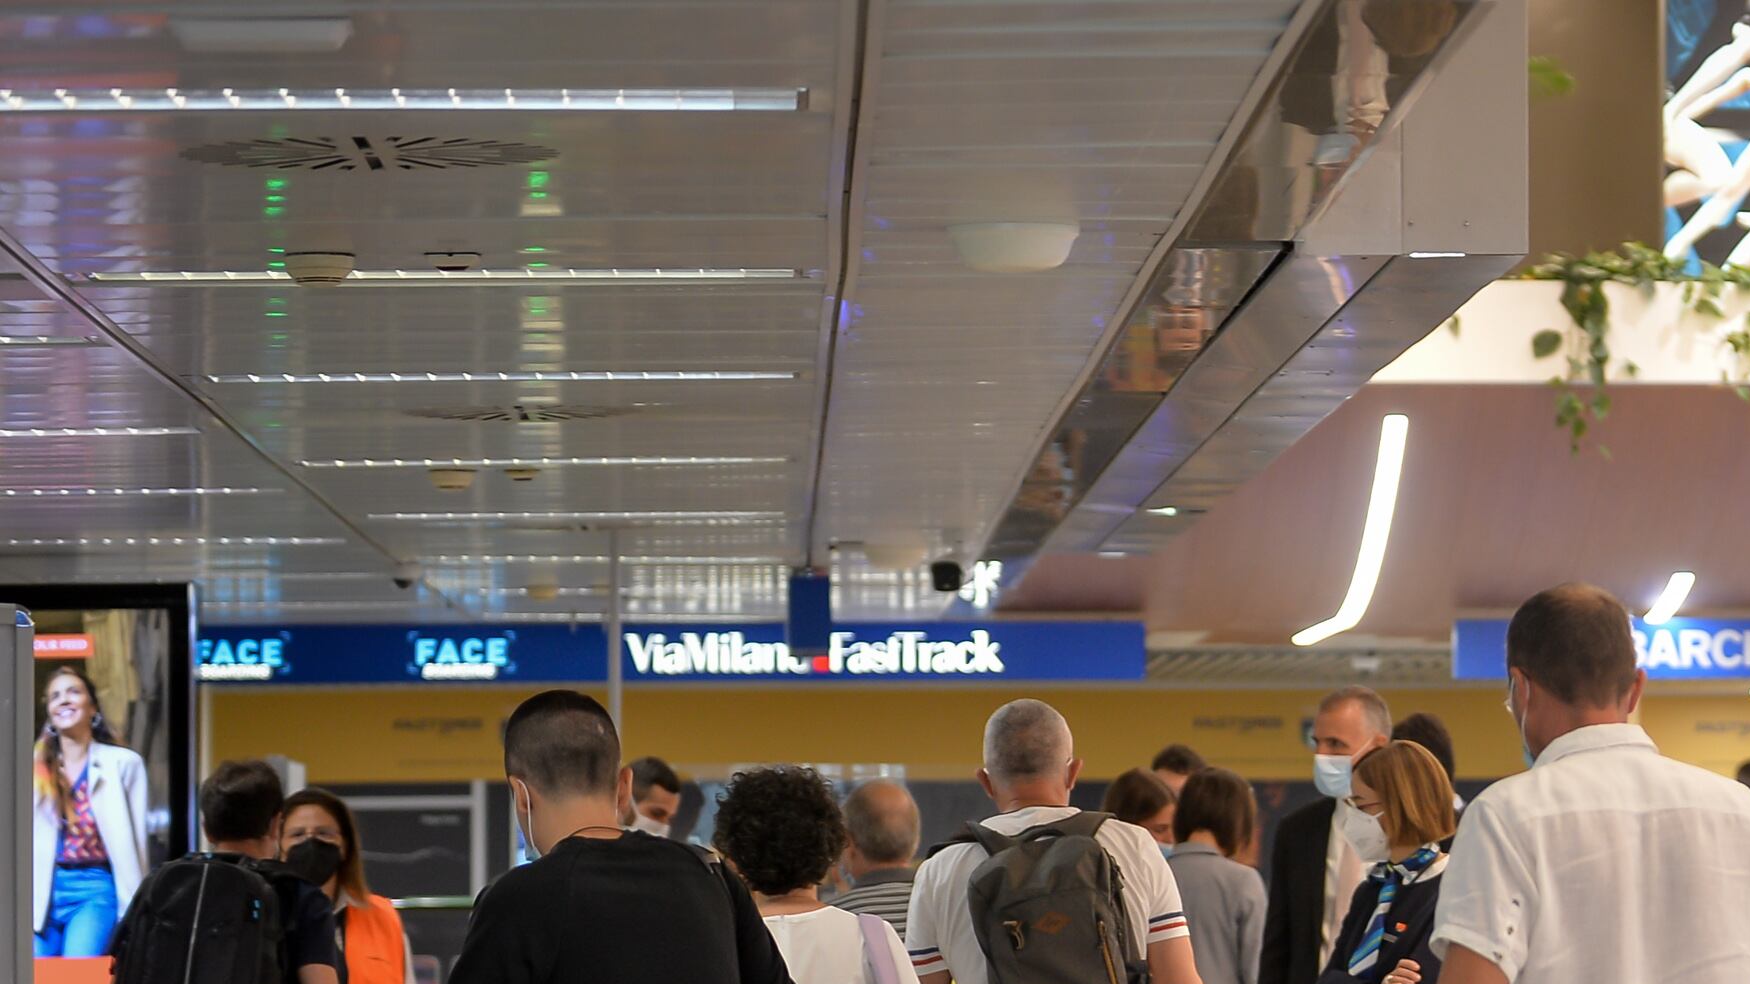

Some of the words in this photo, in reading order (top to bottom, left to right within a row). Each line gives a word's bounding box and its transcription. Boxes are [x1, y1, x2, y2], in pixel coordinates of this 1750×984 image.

[414, 638, 509, 666] FACE
[624, 631, 808, 673] ViaMilan
[828, 630, 1004, 673] FastTrack
